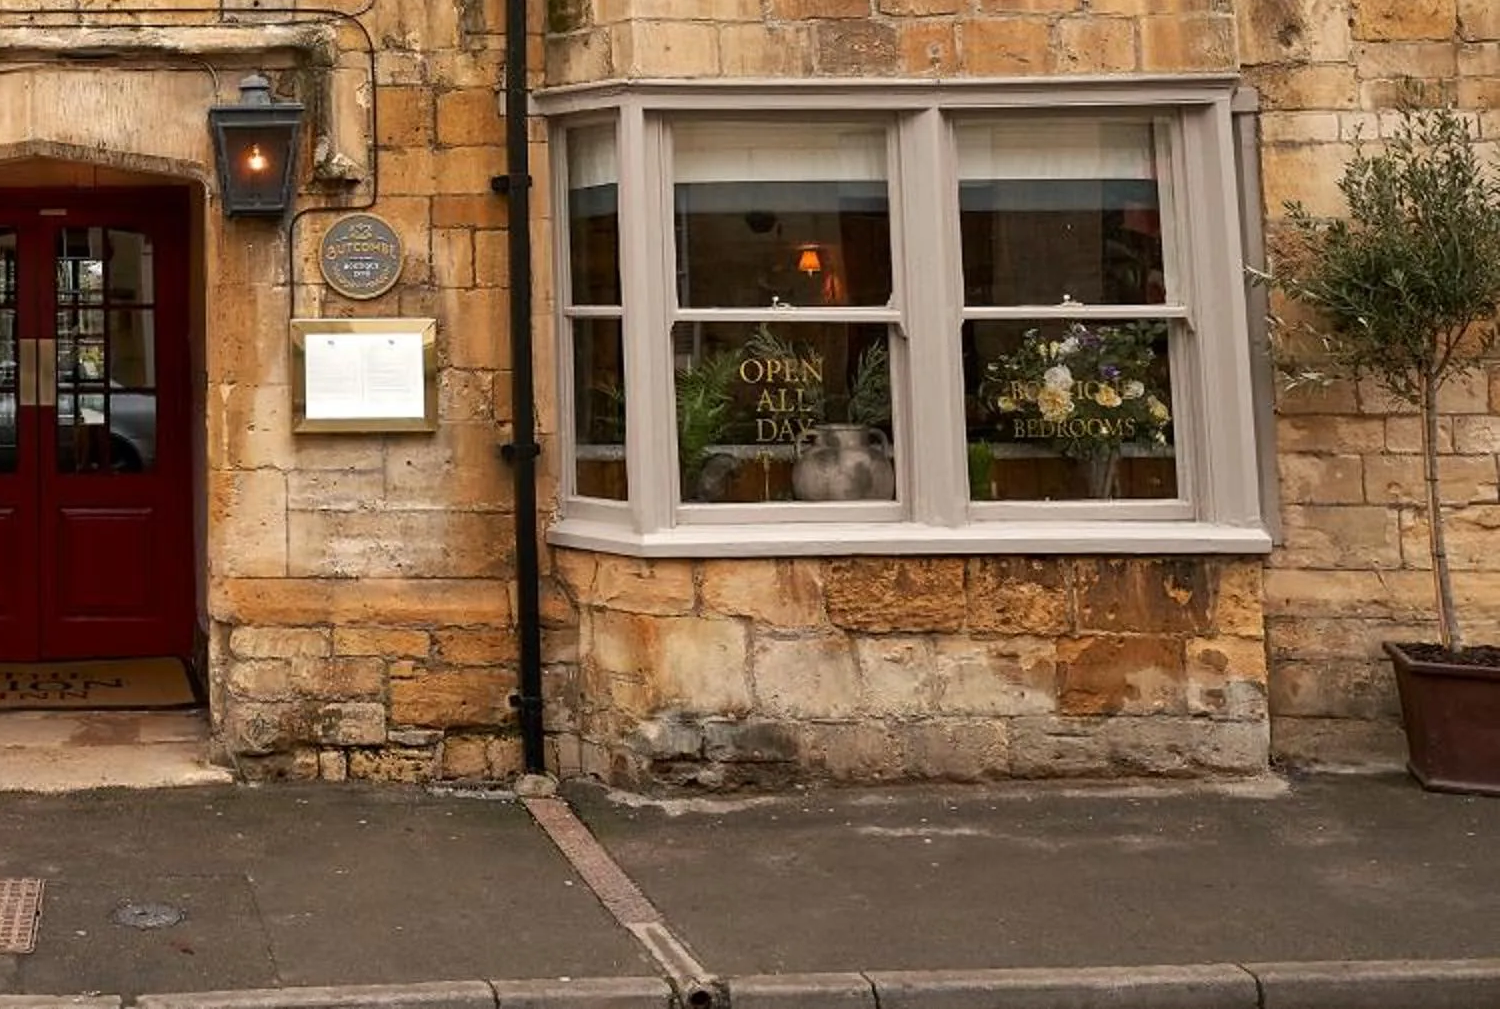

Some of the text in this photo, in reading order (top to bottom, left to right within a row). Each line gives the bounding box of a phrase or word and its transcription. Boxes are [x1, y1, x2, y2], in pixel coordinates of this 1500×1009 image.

[740, 357, 824, 384] OPEN
[756, 388, 813, 412] ALL
[755, 418, 816, 442] DAY
[1013, 417, 1136, 439] BEDROOMS
